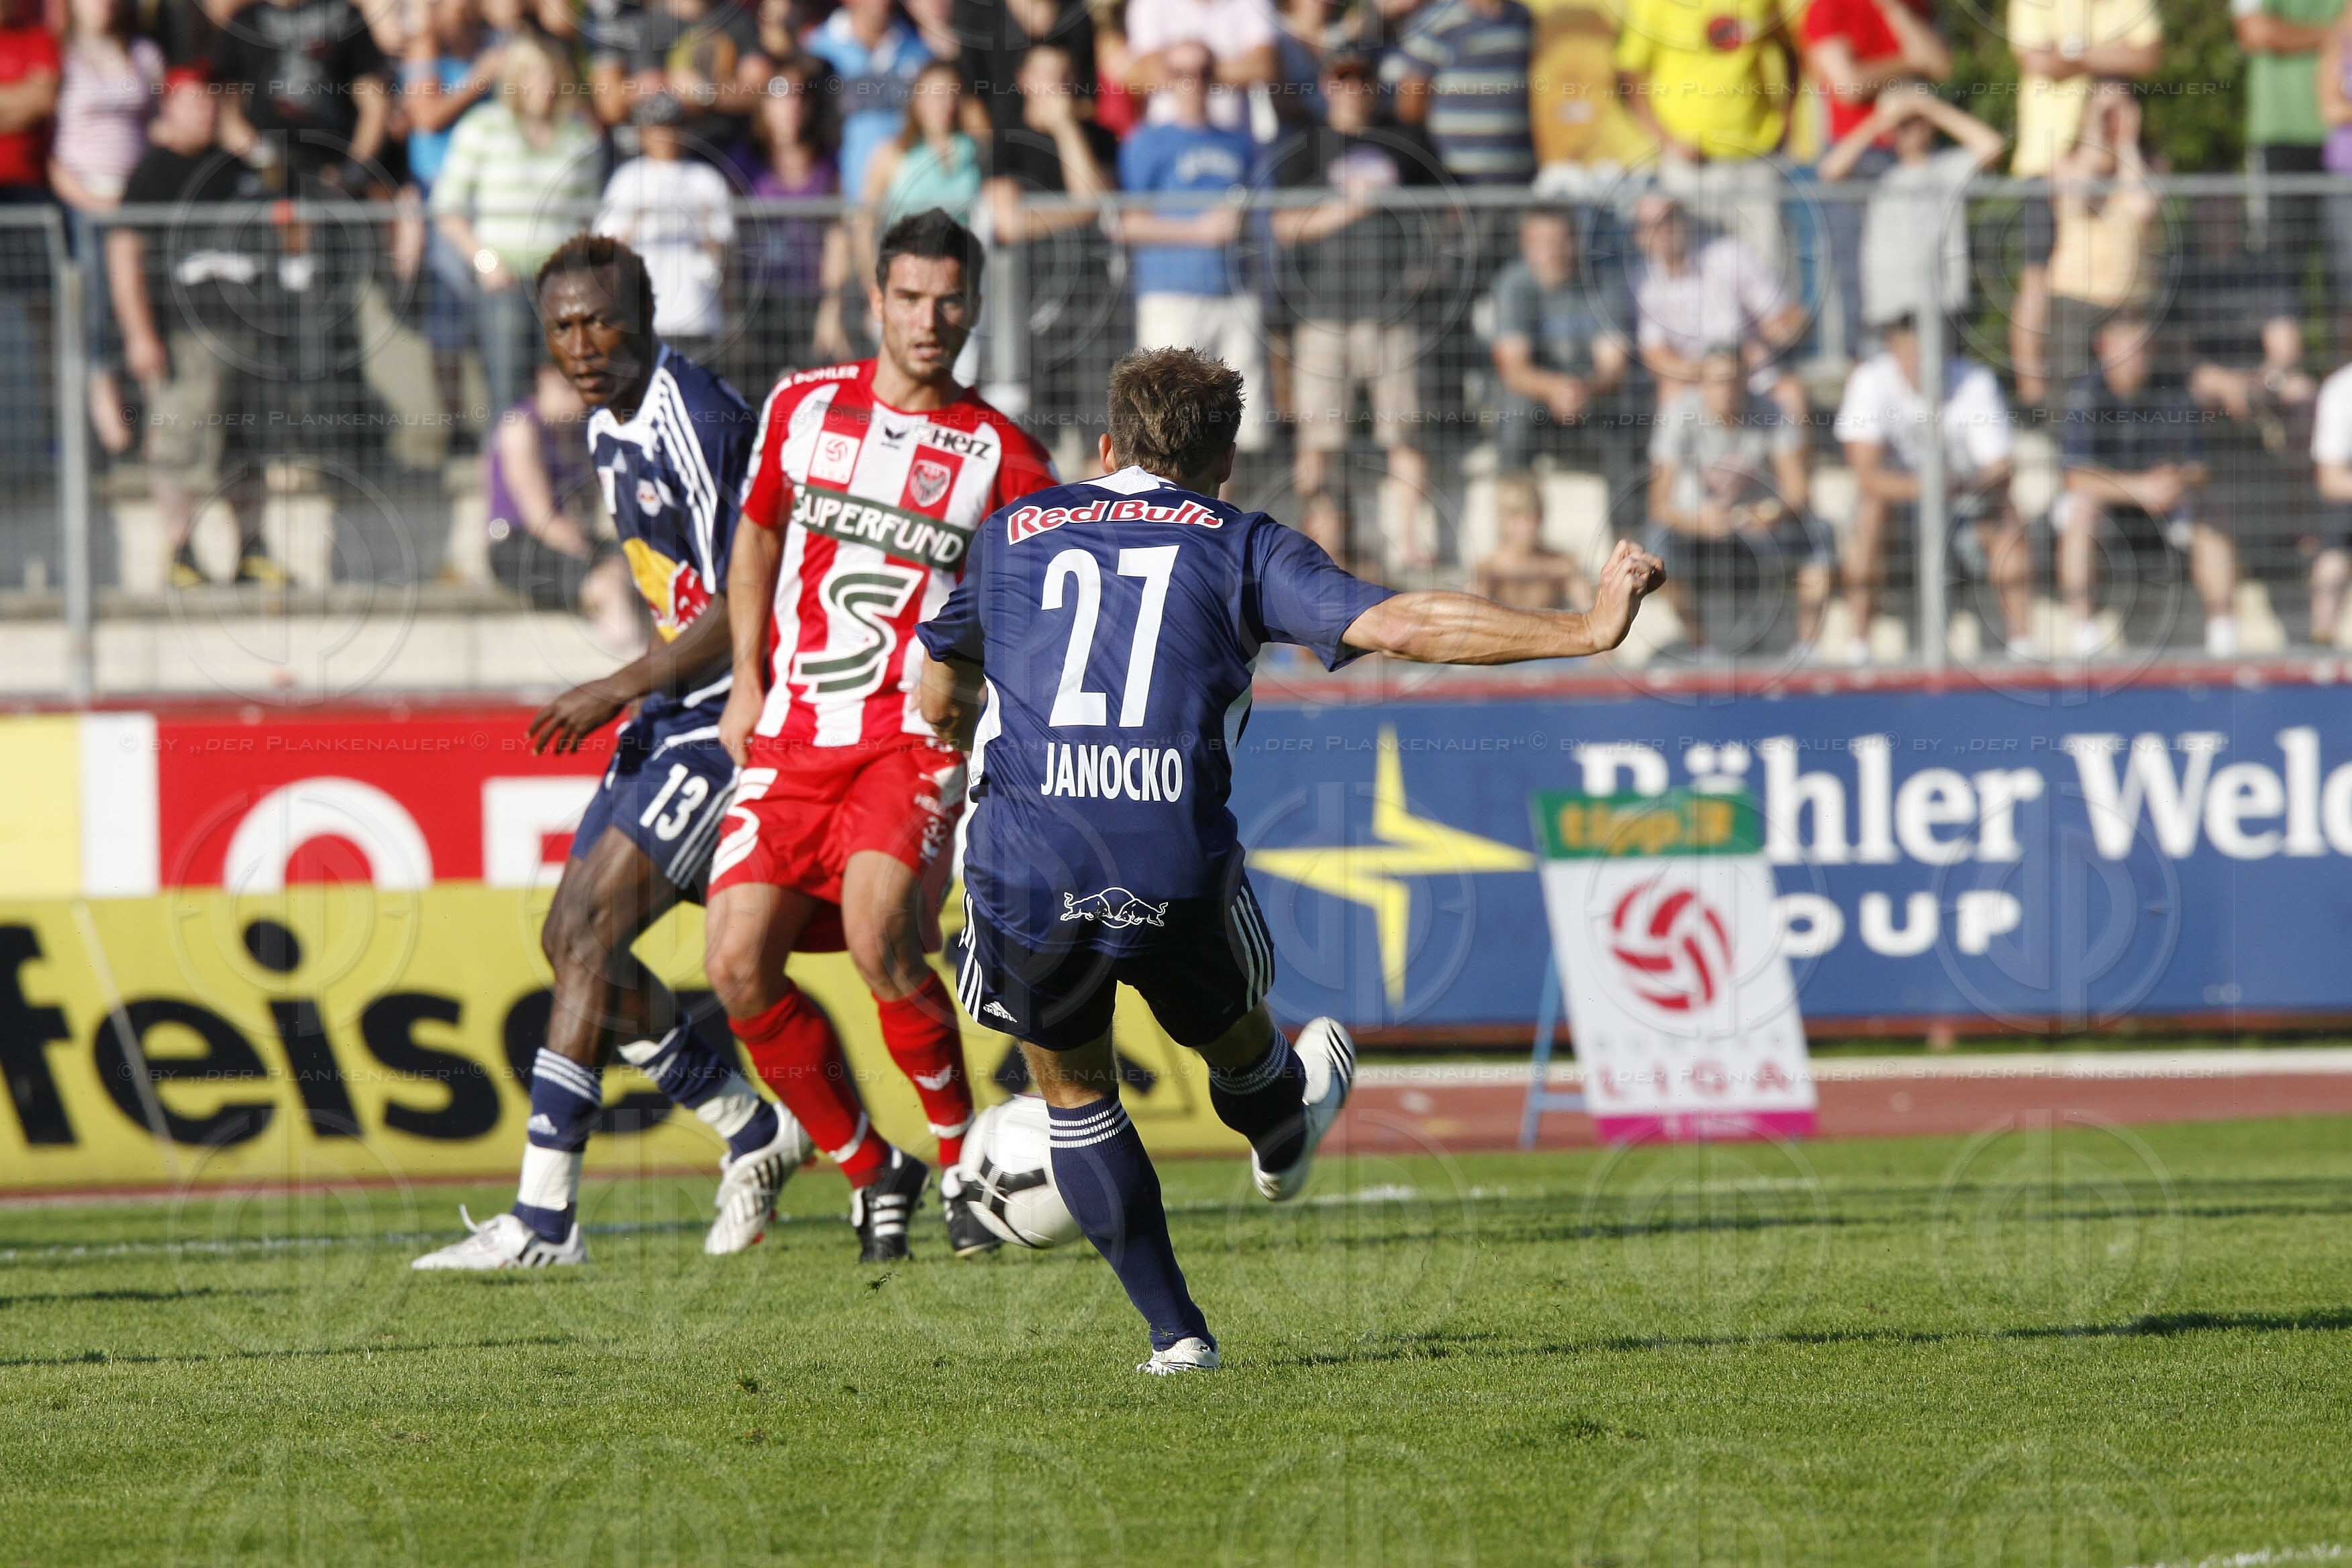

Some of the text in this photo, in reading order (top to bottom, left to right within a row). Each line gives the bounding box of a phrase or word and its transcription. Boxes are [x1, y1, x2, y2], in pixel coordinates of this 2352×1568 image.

[792, 484, 964, 564] SUPERFUND
[1008, 500, 1222, 545] Red Bull
[1041, 544, 1180, 728] 27
[639, 762, 709, 842] 13
[1041, 741, 1183, 803] JANOCKO
[1575, 734, 2045, 866] hler
[1772, 889, 2022, 958] OUP
